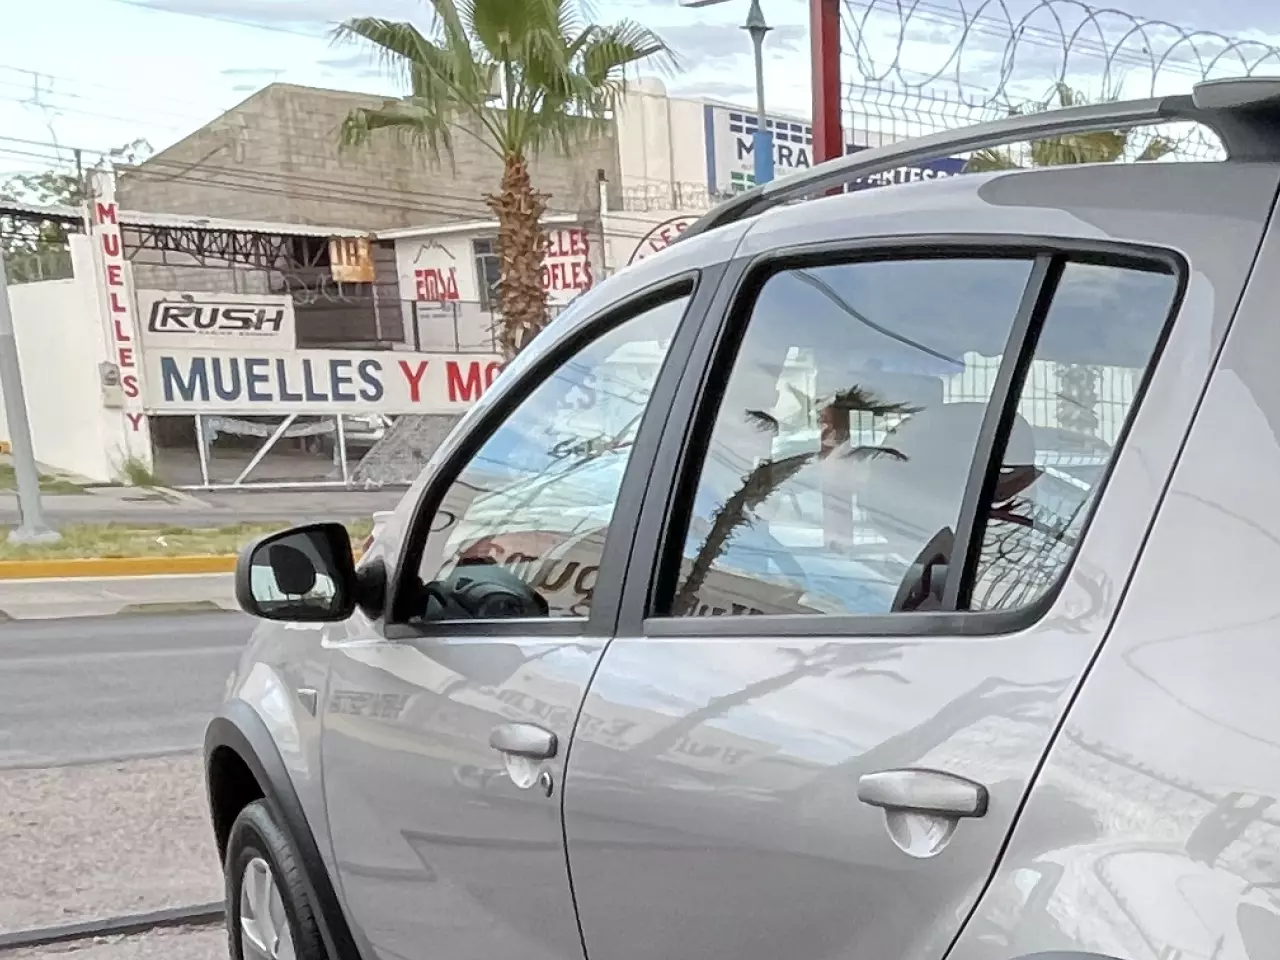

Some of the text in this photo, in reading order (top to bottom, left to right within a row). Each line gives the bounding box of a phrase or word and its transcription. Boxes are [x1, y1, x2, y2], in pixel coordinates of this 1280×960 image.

[95, 203, 141, 397] MUELLES
[160, 306, 284, 332] RUSH
[161, 356, 384, 402] MUELLES
[398, 361, 429, 402] Y
